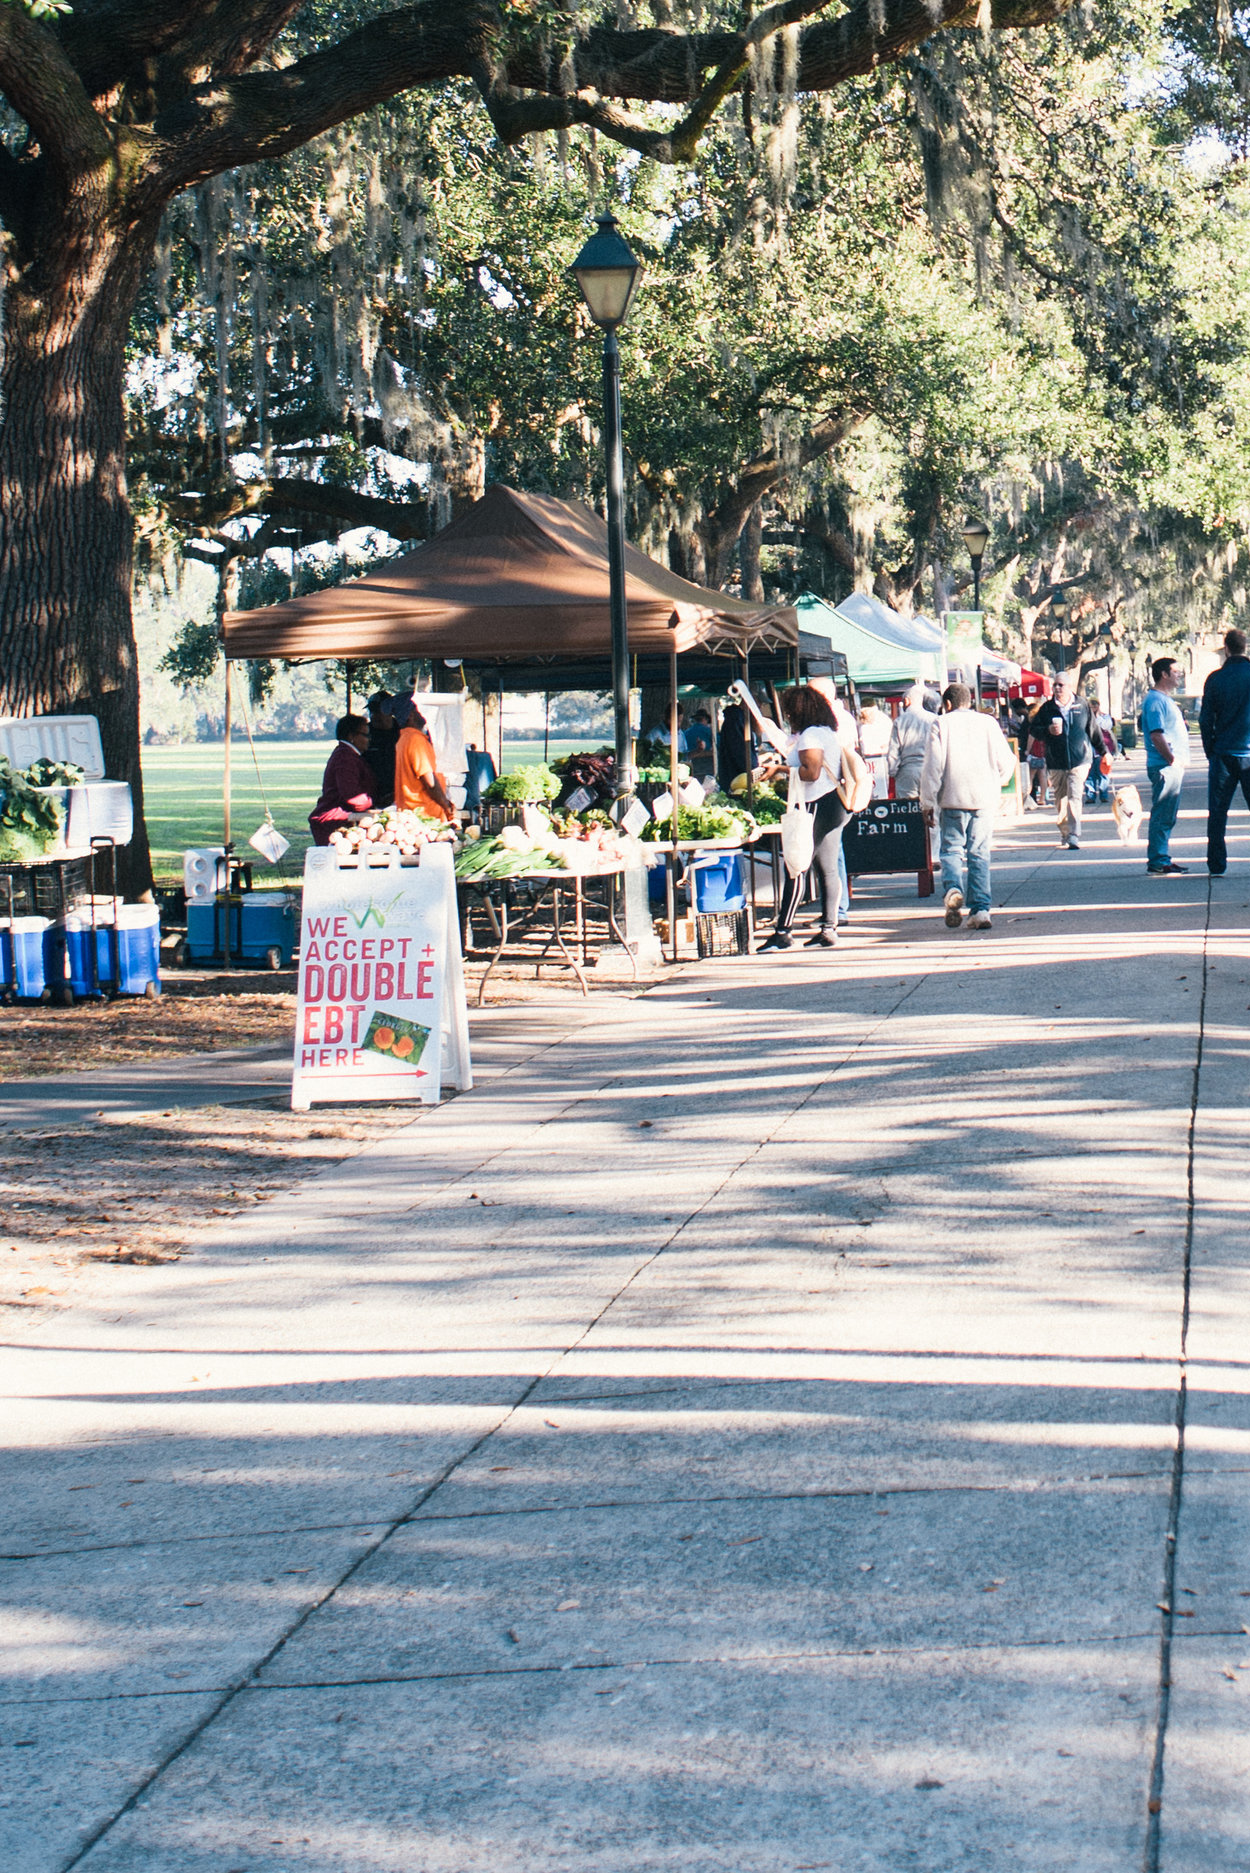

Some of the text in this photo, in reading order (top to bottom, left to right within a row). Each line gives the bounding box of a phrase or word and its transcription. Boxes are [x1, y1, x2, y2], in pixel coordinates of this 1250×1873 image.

[857, 820, 908, 836] Farm
[307, 916, 348, 939] WE
[305, 938, 412, 962] ACCEPT
[304, 961, 435, 1003] DOUBLE
[303, 1004, 366, 1045] EBT
[301, 1047, 365, 1068] HERE
